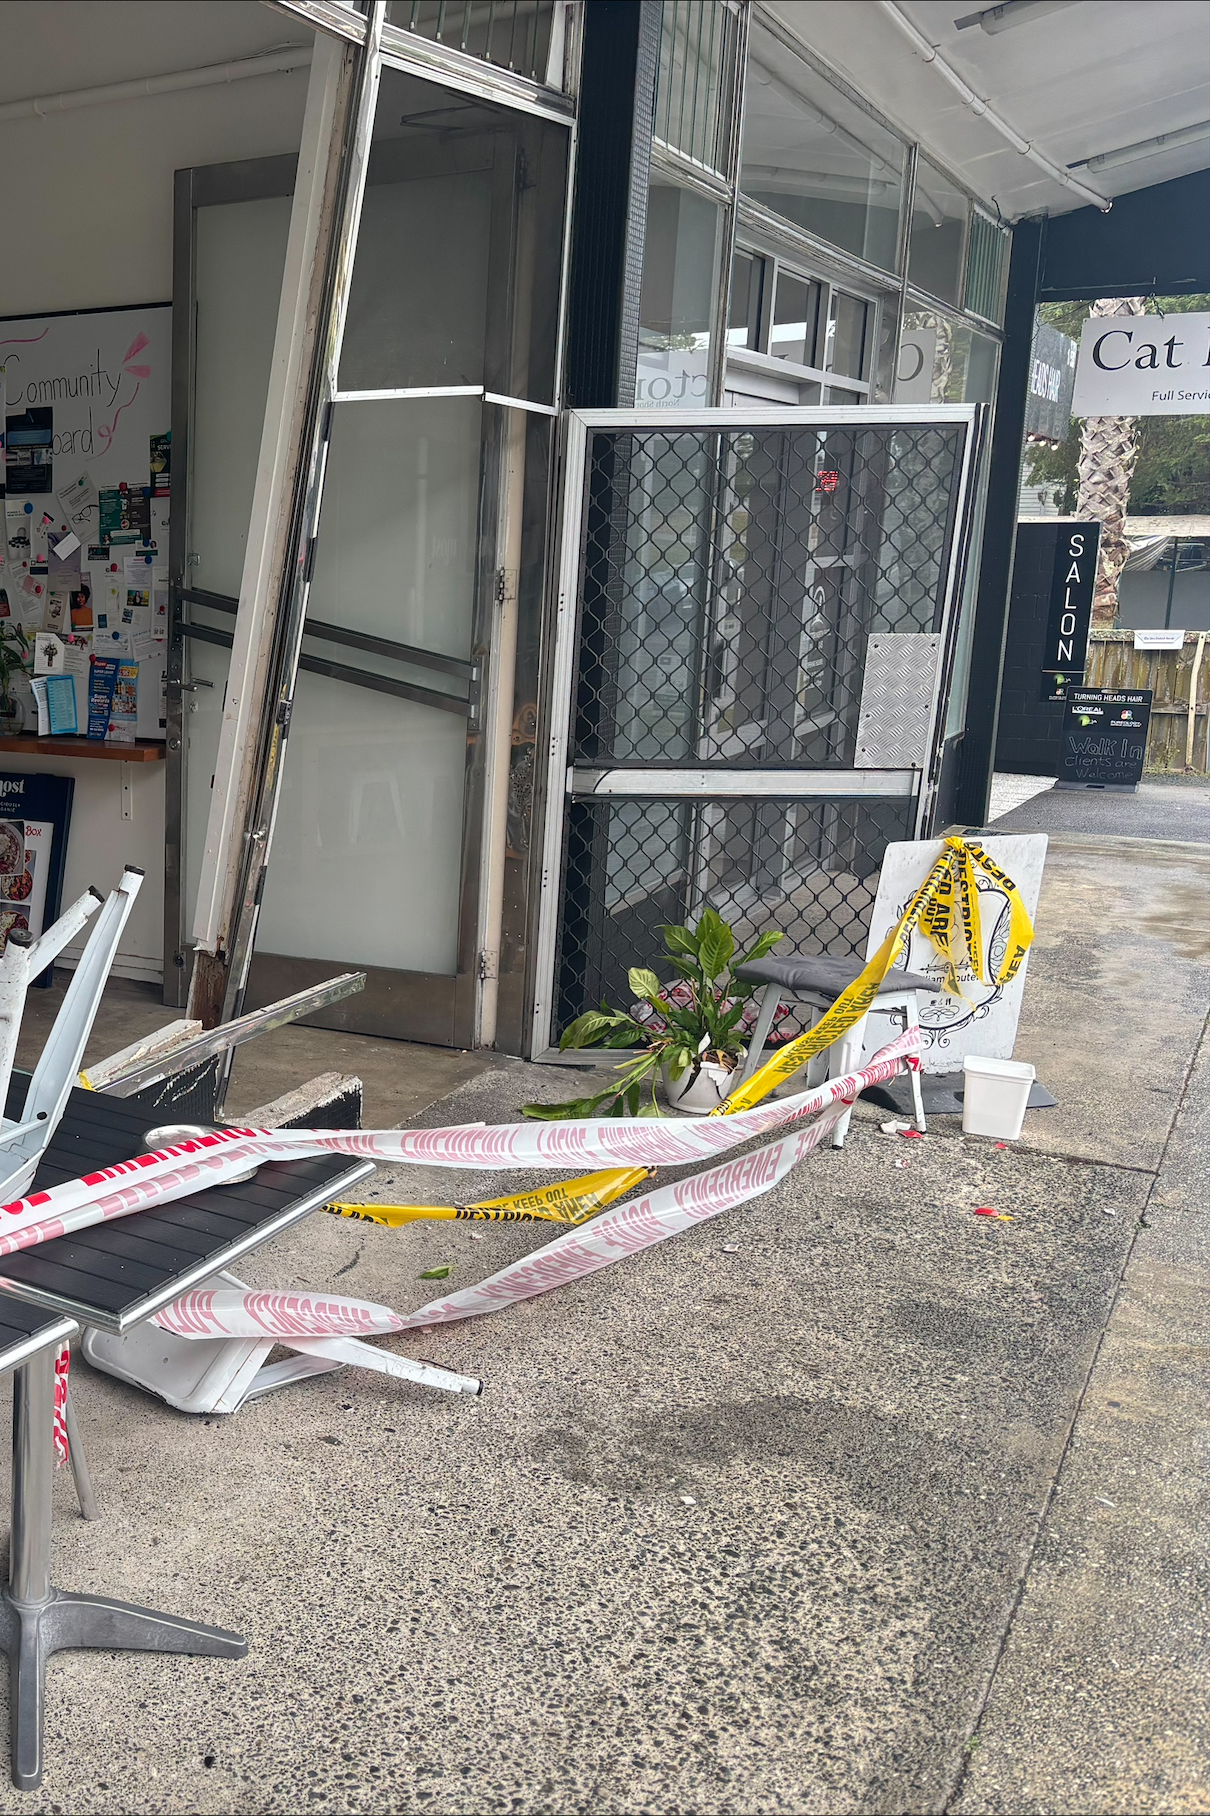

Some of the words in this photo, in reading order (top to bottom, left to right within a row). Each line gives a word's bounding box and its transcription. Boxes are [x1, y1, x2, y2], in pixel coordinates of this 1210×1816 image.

[1092, 330, 1184, 371] Cat
[1151, 390, 1174, 401] Full
[52, 407, 94, 456] oard
[1056, 534, 1085, 662] SALON
[1074, 692, 1102, 702] TURNING
[1103, 694, 1126, 703] HEADS
[1127, 695, 1144, 704] HAIR
[1120, 738, 1144, 760] In
[1114, 760, 1138, 769] are
[1076, 767, 1134, 781] Welcome
